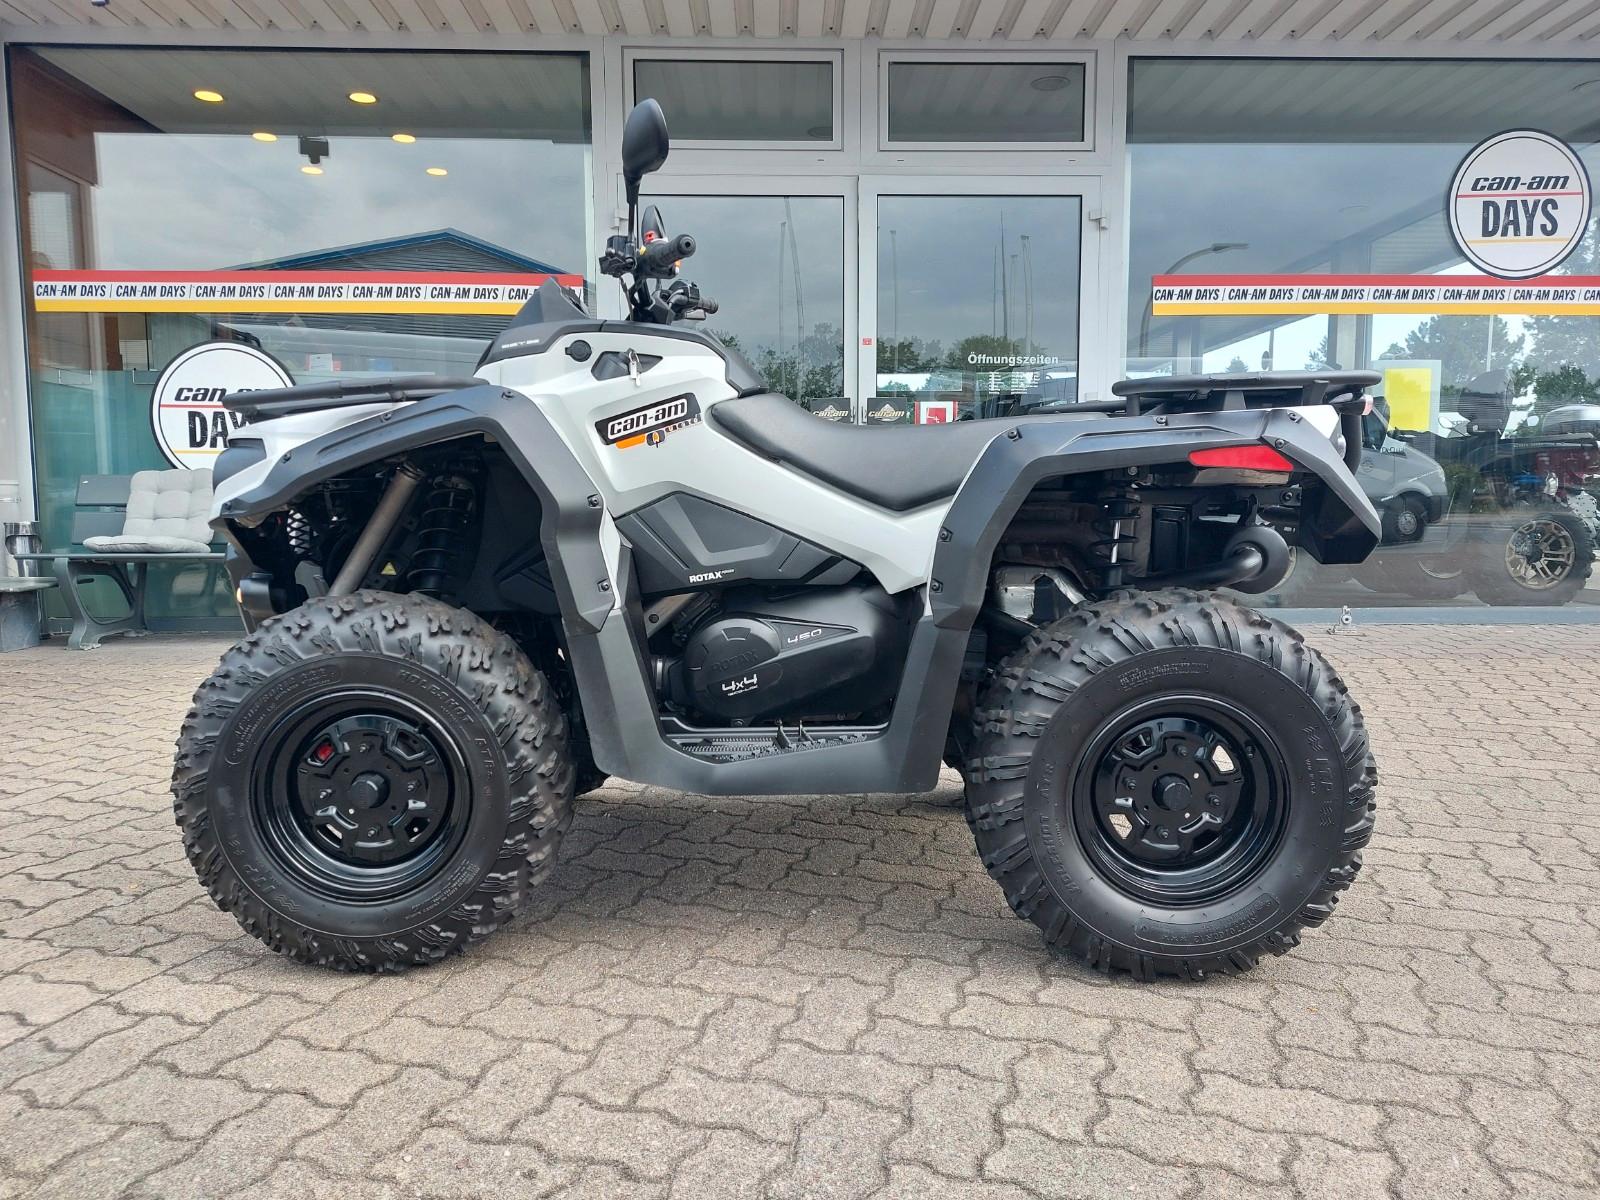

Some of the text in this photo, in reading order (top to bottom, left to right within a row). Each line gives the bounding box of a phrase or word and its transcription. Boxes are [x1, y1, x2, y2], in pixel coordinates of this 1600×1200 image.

[1471, 175, 1570, 191] can-am
[1481, 198, 1559, 238] DAYS
[36, 284, 77, 297] CAN-AM
[80, 284, 106, 297] DAYS
[115, 285, 157, 298] CAN-AM
[160, 285, 186, 298] DAYS
[195, 285, 236, 298] CAN-AM
[239, 285, 265, 298] DAYS
[274, 285, 314, 298] CAN-AM
[317, 285, 343, 298] DAYS
[352, 286, 393, 299] CAN-AM
[395, 286, 422, 299] DAYS
[430, 286, 470, 299] CAN-AM
[473, 286, 499, 299] DAYS
[1154, 288, 1193, 301] CAN-AM
[1194, 288, 1219, 301] DAYS
[1228, 288, 1267, 301] CAN-AM
[1269, 288, 1294, 301] DAYS
[1301, 288, 1339, 301] CAN-AM
[1341, 288, 1365, 301] DAYS
[1372, 288, 1409, 301] CAN-AM
[1411, 288, 1436, 301] DAYS
[1443, 288, 1480, 301] CAN-AM
[1482, 288, 1506, 301] DAYS
[1513, 288, 1550, 301] CAN-AM
[1552, 288, 1576, 301] DAYS
[967, 351, 1059, 367] Öffnungszeiten
[609, 401, 686, 436] can-am
[689, 570, 723, 583] ROTAX
[787, 628, 822, 644] 450
[721, 673, 758, 692] 4x4
